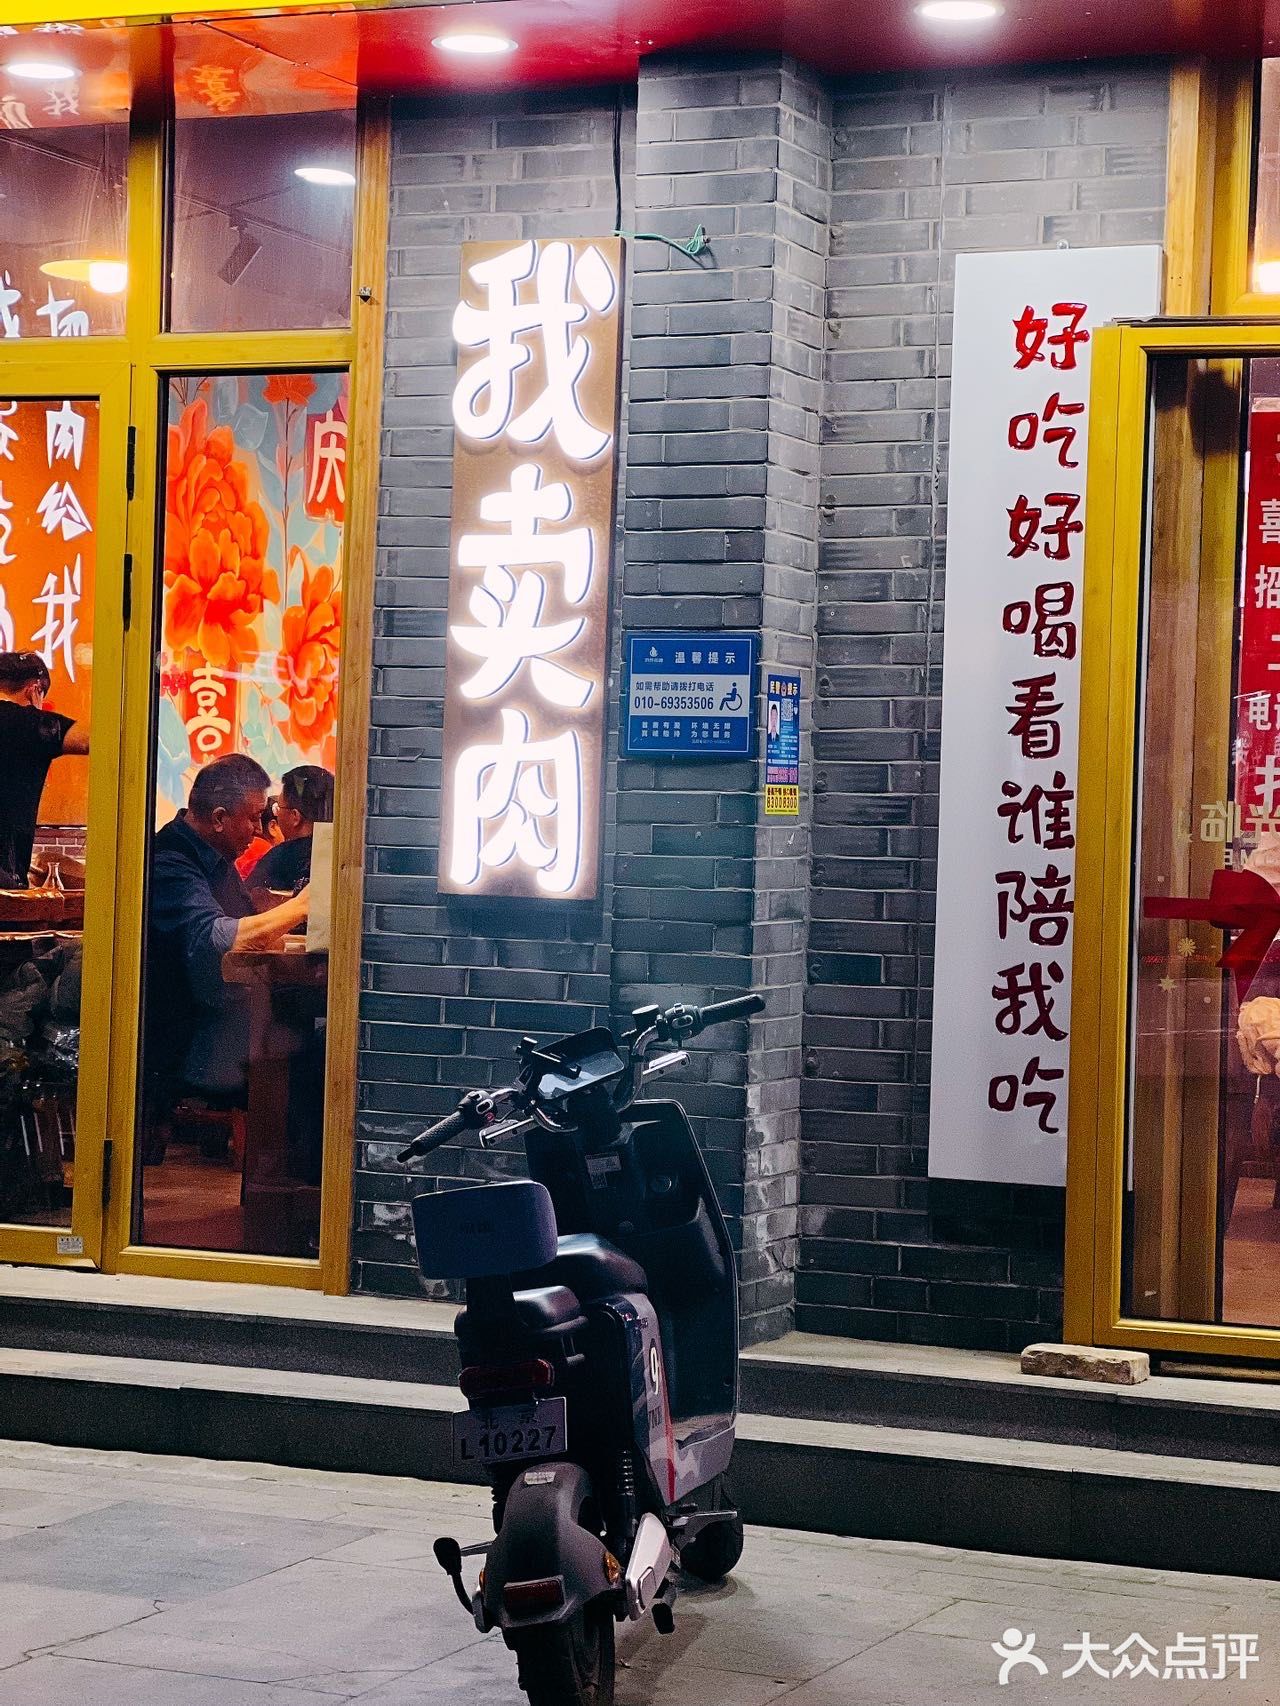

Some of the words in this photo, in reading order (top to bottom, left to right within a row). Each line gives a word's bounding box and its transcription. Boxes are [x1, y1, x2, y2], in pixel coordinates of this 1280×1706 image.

[452, 239, 617, 893] 我卖肉
[675, 651, 736, 665] 温馨提示
[634, 695, 714, 710] 010-69353506
[635, 681, 715, 692] 如需帮助请拨打电话
[988, 302, 1091, 1134] 好吃好喝看谁陪我吃
[1249, 692, 1280, 731] 电
[460, 1424, 557, 1460] L10227
